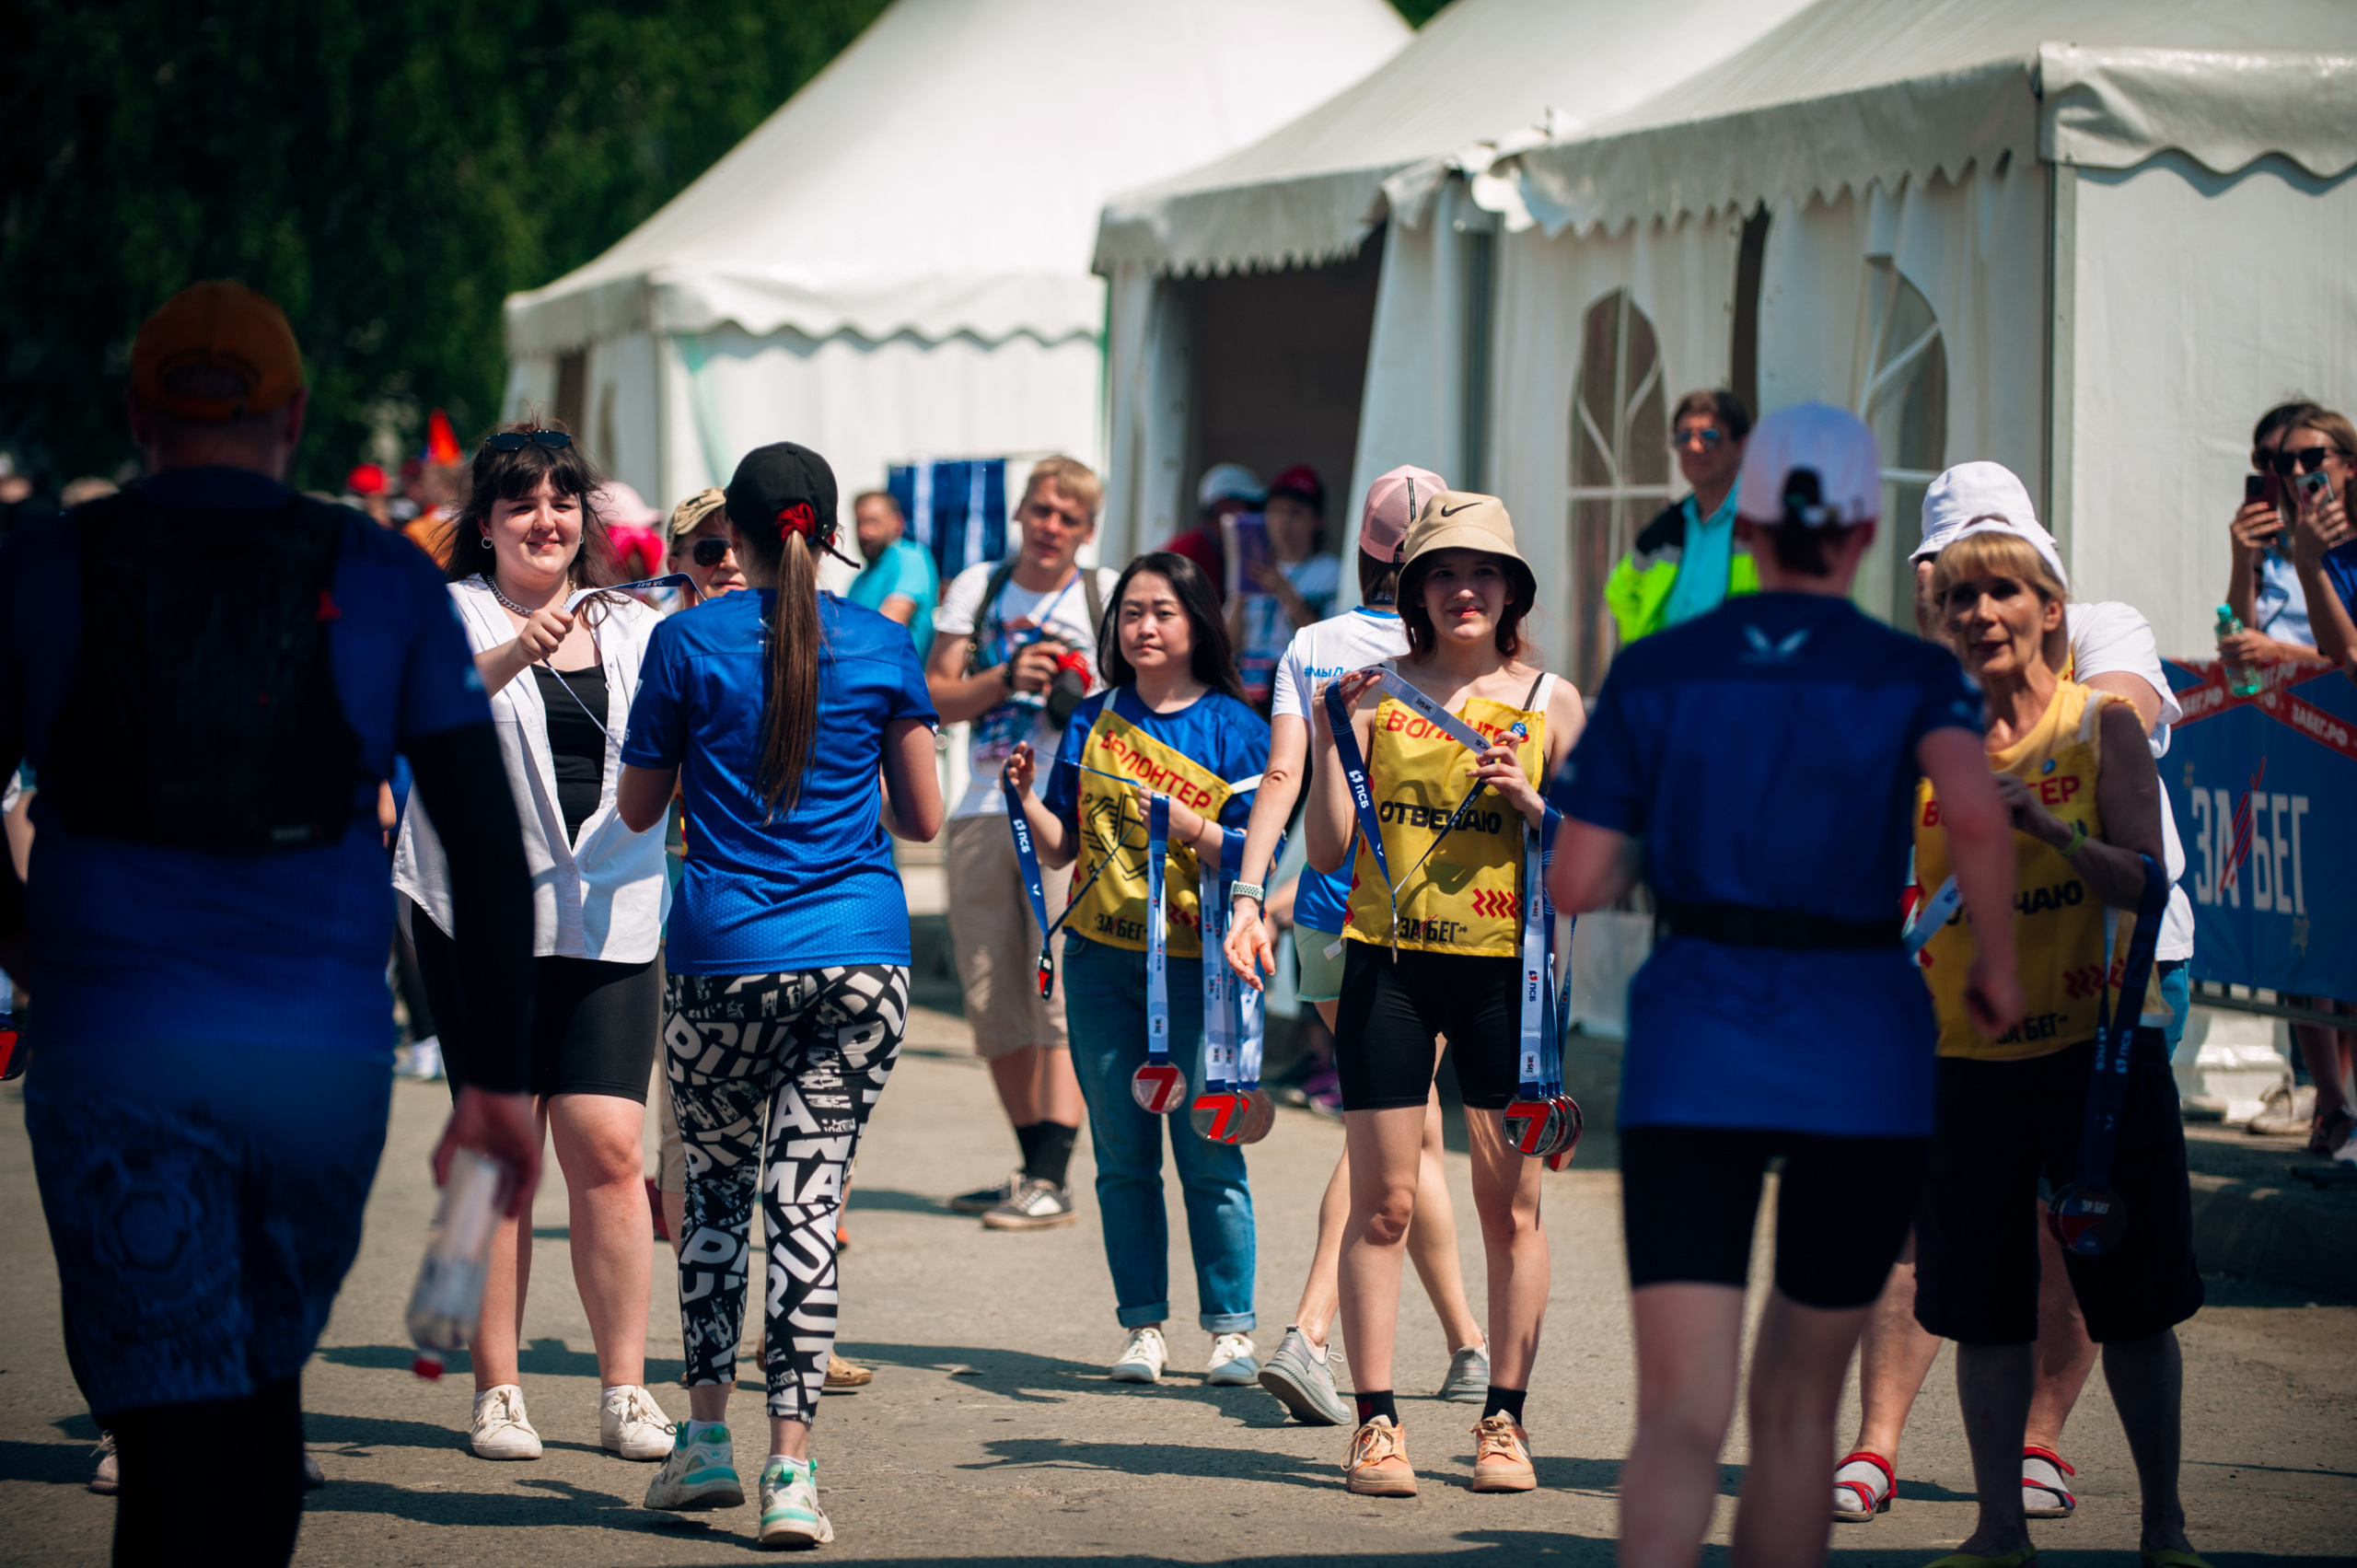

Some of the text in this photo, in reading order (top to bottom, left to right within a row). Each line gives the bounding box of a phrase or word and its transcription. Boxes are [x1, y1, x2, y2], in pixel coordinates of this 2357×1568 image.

[1355, 785, 1369, 809] ПСБ
[1136, 1067, 1179, 1111] 7
[1193, 1095, 1237, 1139] 7
[1505, 1102, 1551, 1153] 7
